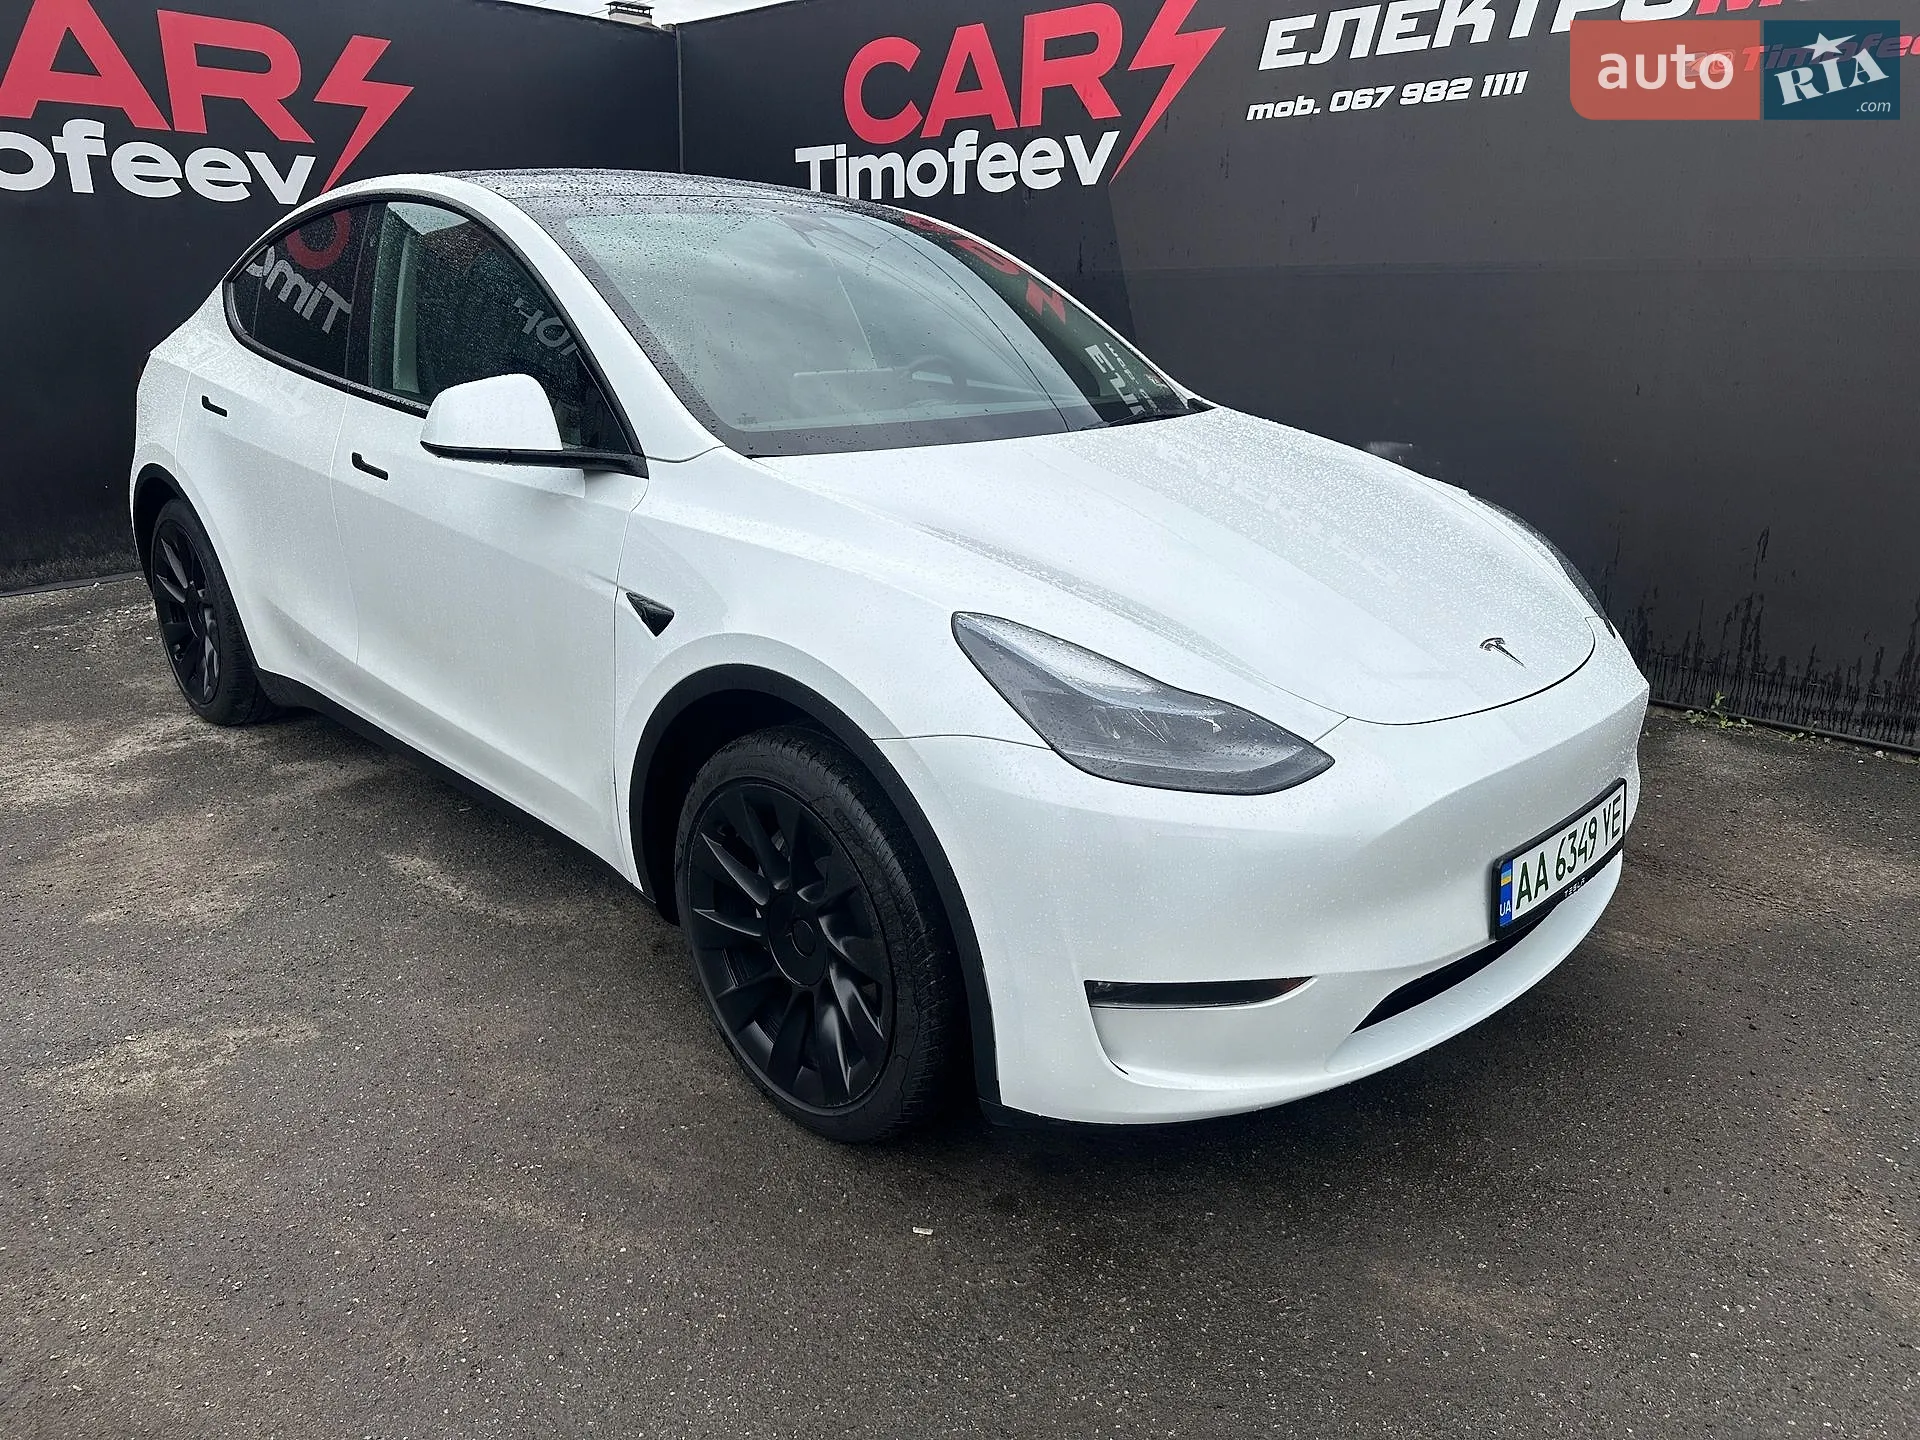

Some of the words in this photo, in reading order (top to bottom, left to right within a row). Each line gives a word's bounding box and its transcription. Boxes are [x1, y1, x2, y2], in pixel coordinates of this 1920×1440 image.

[1246, 95, 1321, 120] mob.
[1329, 85, 1395, 113] 067
[1400, 77, 1473, 105] 982
[1480, 71, 1529, 98] 1111
[795, 130, 1120, 200] Timofeev
[1516, 851, 1549, 910] AA
[1555, 816, 1598, 881] 6349
[1603, 794, 1621, 846] YE
[1500, 900, 1512, 916] UA
